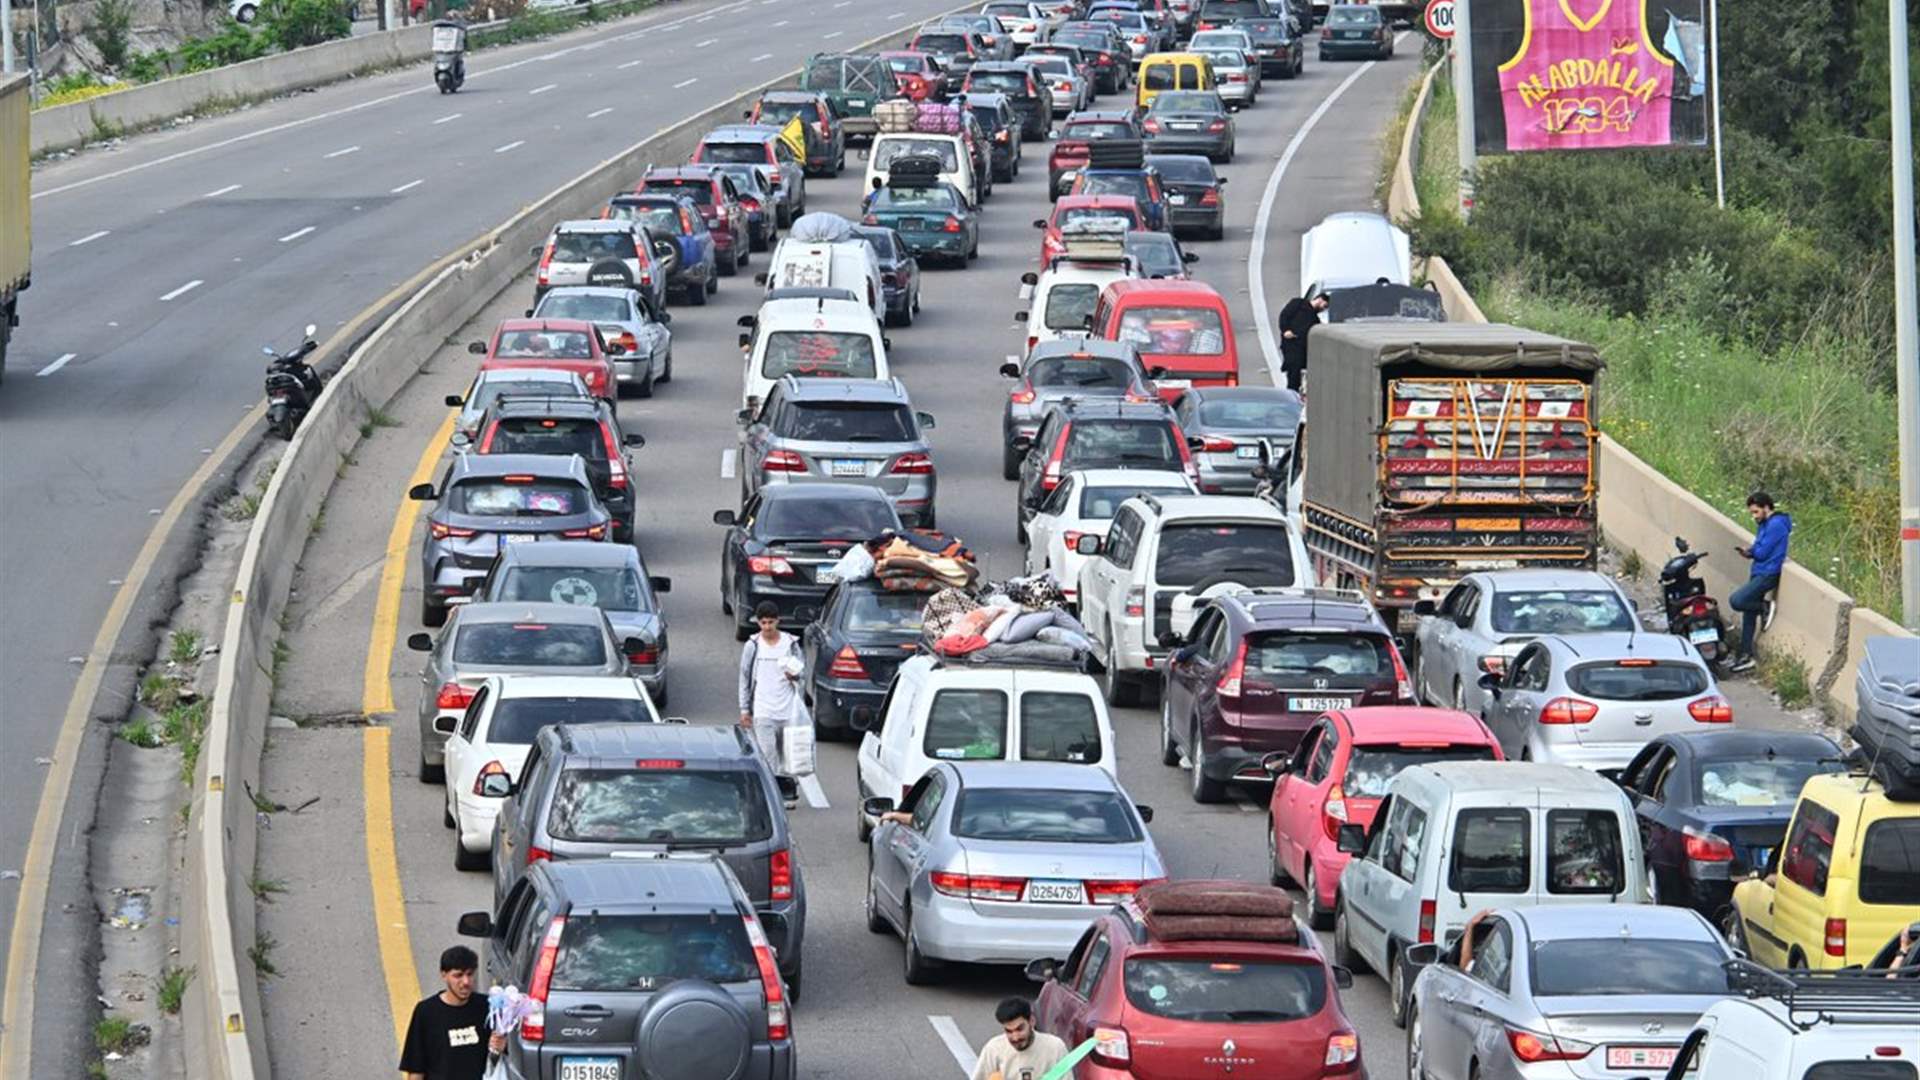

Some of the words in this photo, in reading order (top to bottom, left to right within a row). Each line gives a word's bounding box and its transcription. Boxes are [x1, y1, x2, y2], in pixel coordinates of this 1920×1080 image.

[1297, 699, 1303, 709] N
[1310, 699, 1345, 709] 125172
[1614, 1052, 1631, 1064] 50
[1649, 1052, 1675, 1064] 571
[562, 1066, 619, 1080] 0151849
